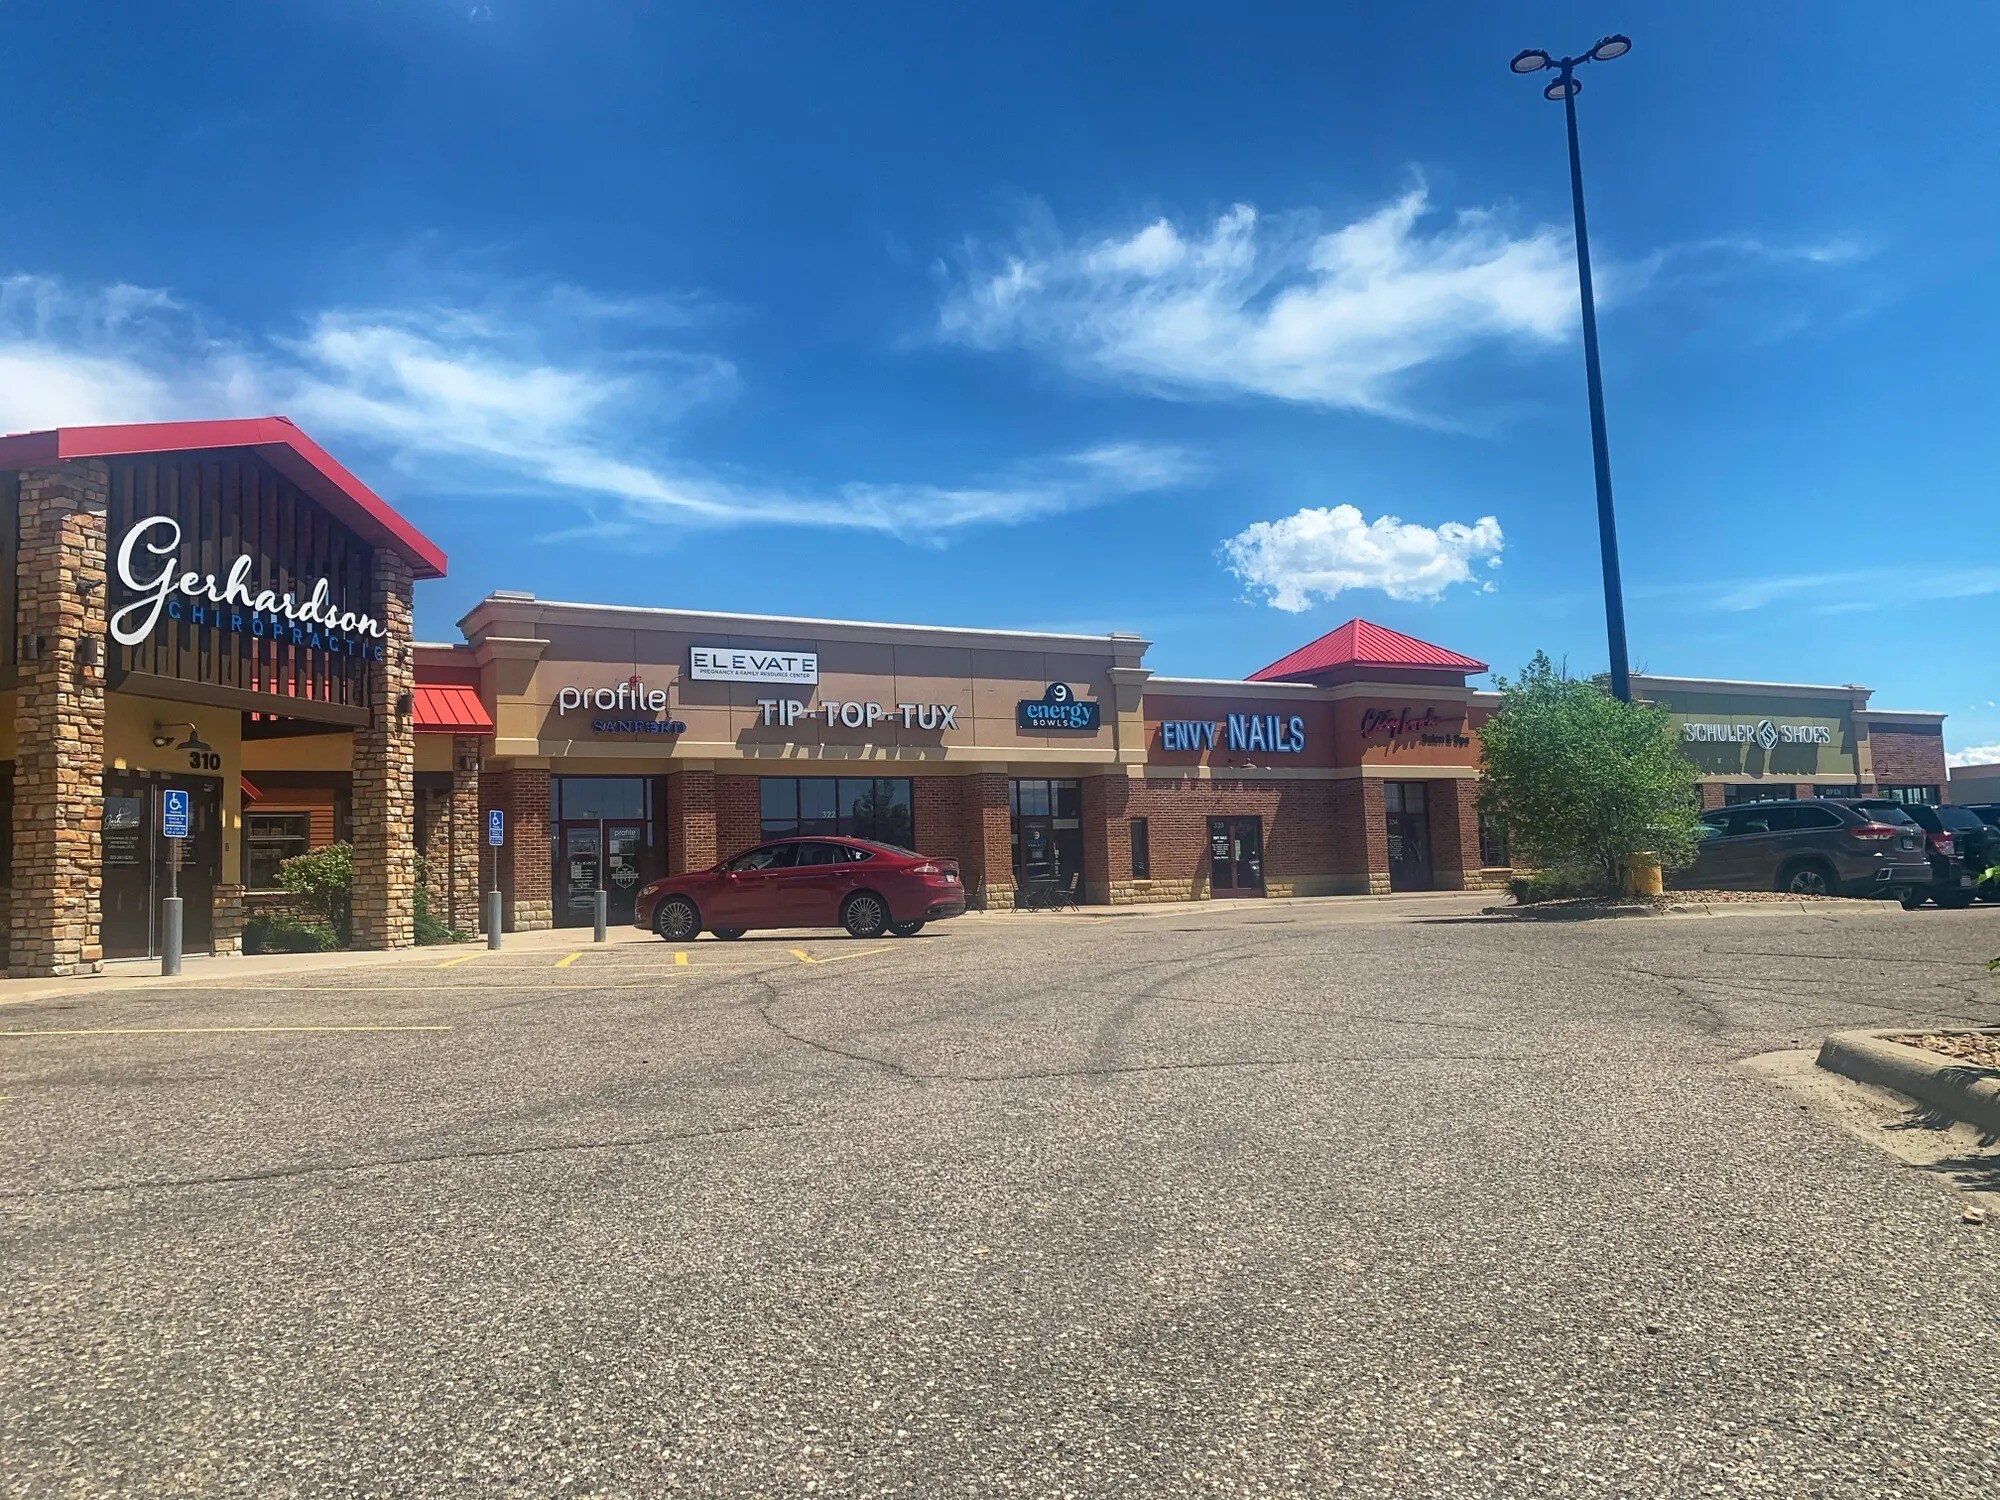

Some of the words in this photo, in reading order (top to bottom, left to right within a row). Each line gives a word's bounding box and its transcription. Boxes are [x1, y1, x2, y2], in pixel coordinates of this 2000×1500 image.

[110, 515, 388, 646] Gerhardson
[166, 599, 384, 662] CHIROPRACTIC
[693, 653, 816, 673] ELEVATE
[699, 668, 733, 676] PREGNANCY
[760, 671, 789, 679] RESOURCE
[559, 677, 667, 716] profile
[1054, 684, 1067, 702] 9
[1026, 702, 1093, 728] energy
[1033, 719, 1068, 727] BOWLS
[1162, 720, 1217, 751] ENVY
[1227, 713, 1305, 753] NAILS
[1683, 722, 1756, 743] SCHULER
[1780, 725, 1831, 744] SHOES
[190, 751, 221, 770] 310
[1826, 788, 1842, 796] OPEN
[614, 829, 636, 837] profile
